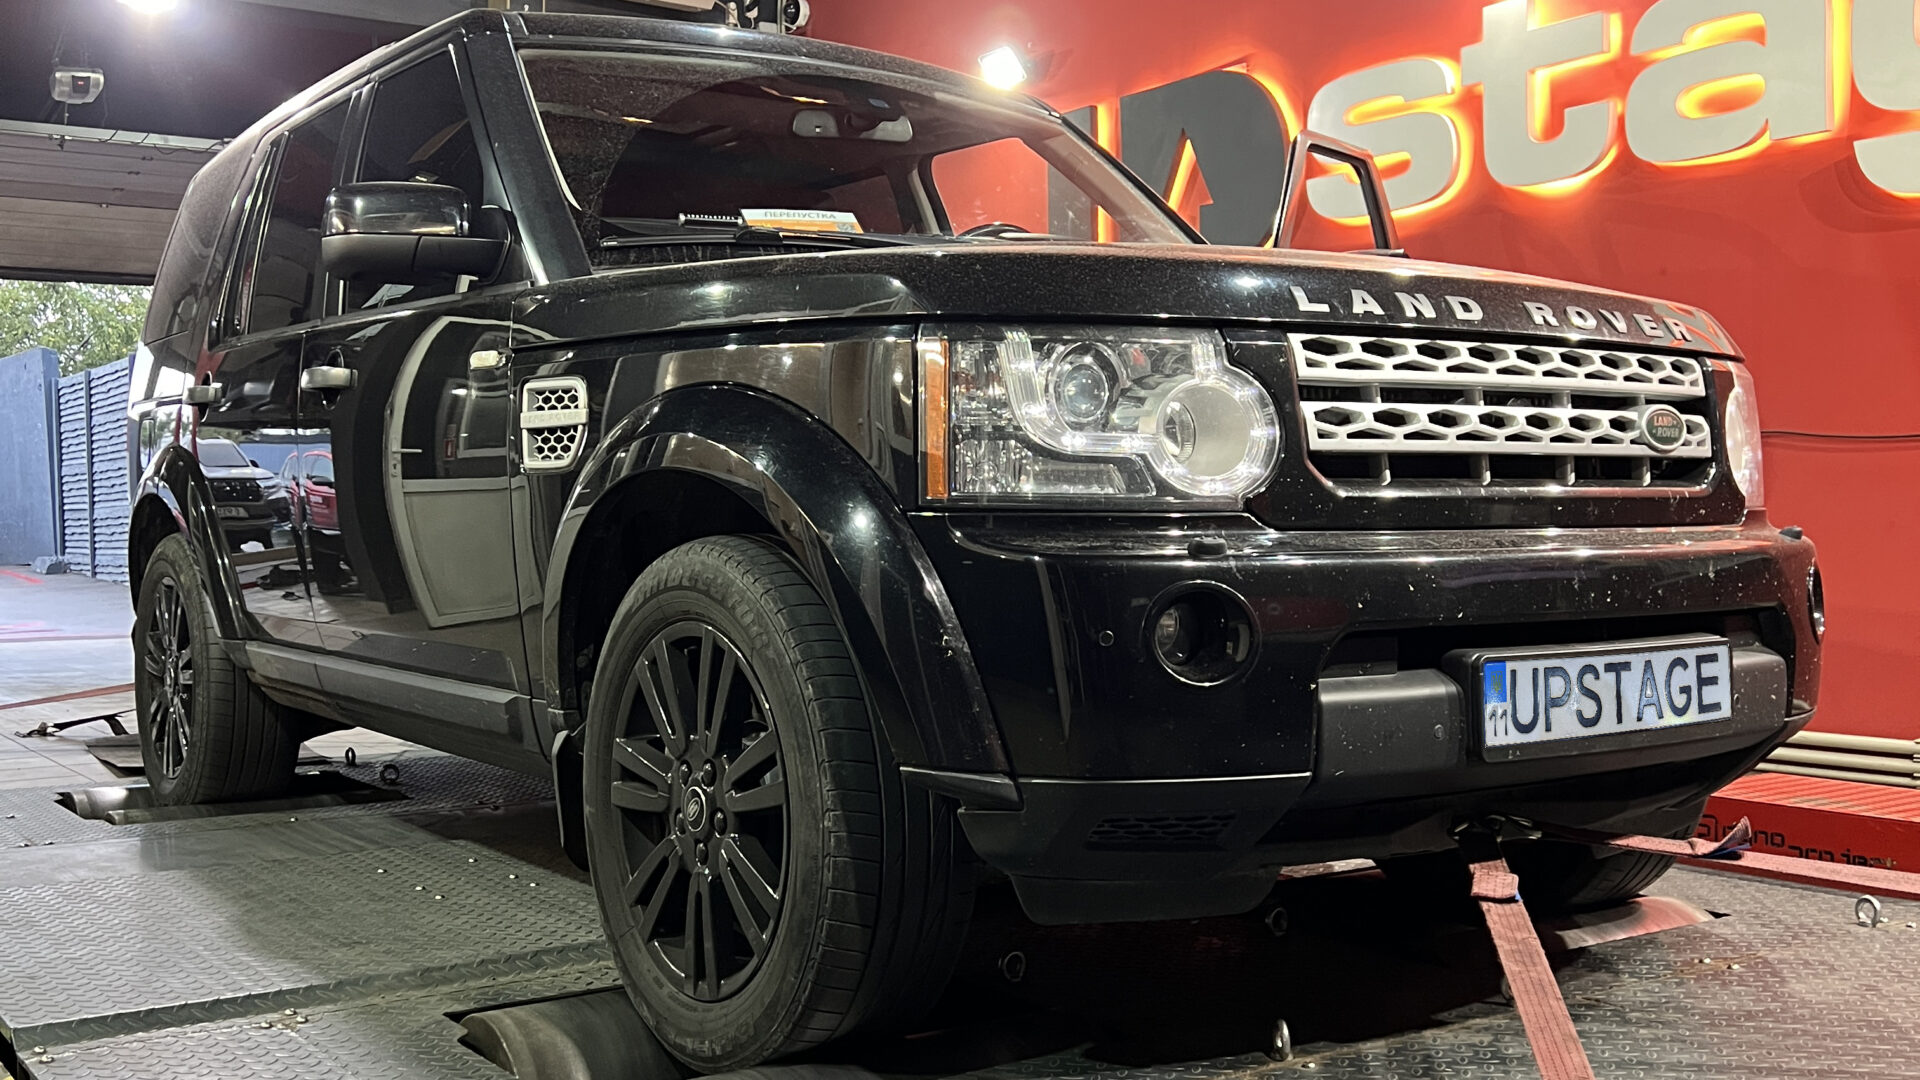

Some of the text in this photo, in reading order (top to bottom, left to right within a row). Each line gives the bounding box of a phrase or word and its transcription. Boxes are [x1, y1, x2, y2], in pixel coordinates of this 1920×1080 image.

[764, 211, 836, 219] ПЕРЕПУСТКА
[1289, 285, 1693, 342] LAND ROVER
[1653, 415, 1673, 427] LAND
[1657, 427, 1679, 438] ROVER
[1489, 653, 1722, 737] 11 UPSTAGE
